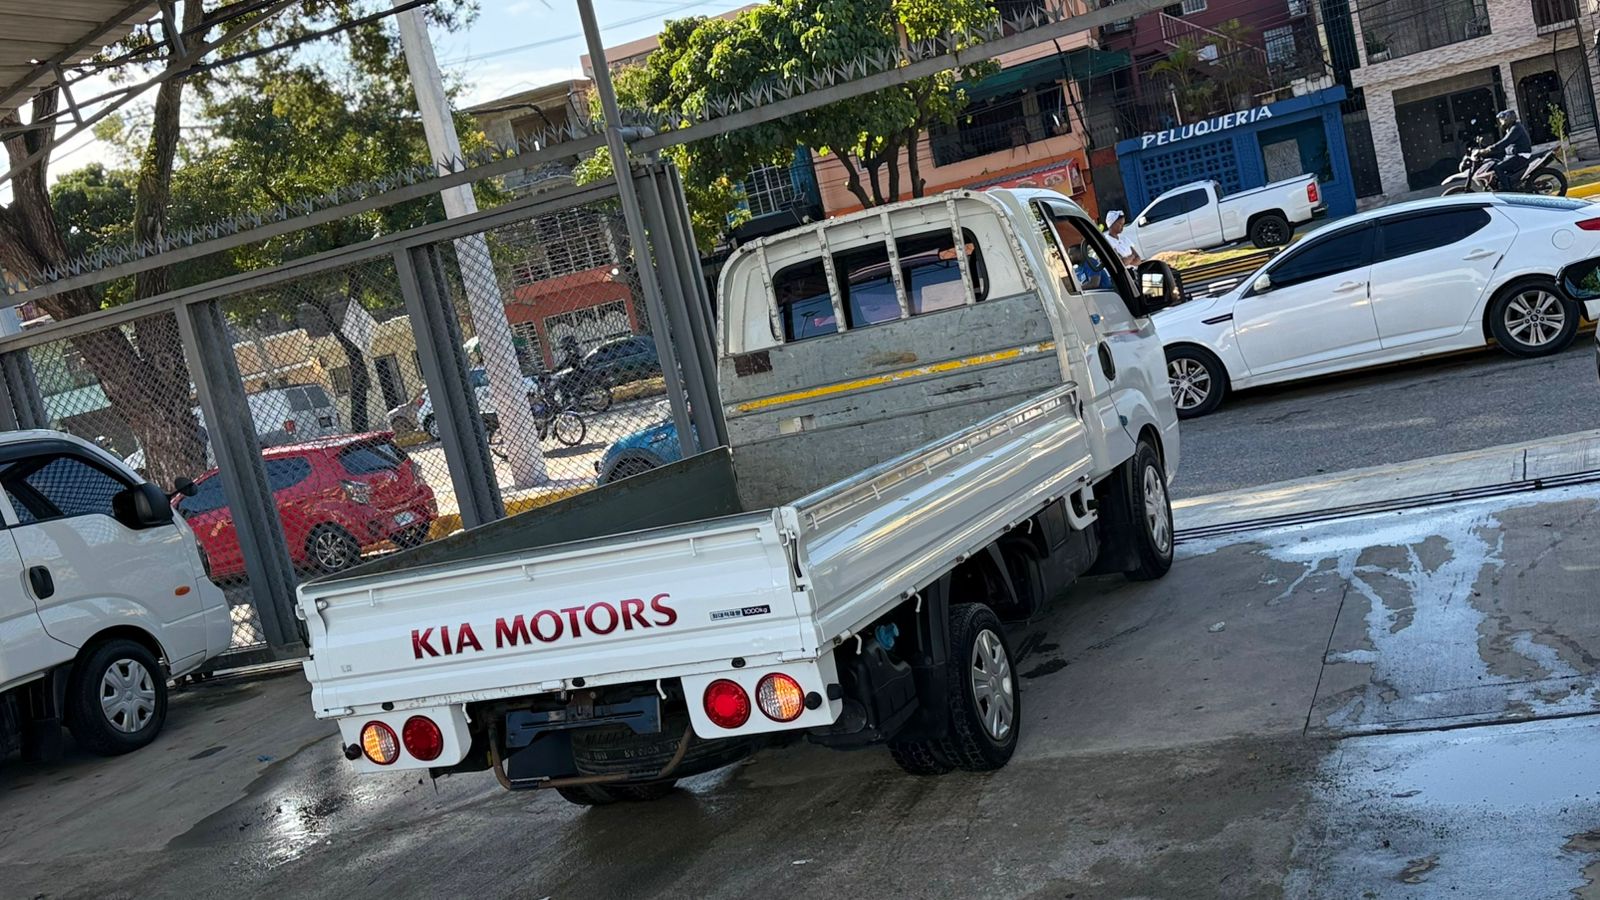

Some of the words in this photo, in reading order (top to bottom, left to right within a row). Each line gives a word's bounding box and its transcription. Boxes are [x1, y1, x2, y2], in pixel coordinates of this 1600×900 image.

[1141, 105, 1273, 149] PELUQUERIA
[411, 622, 484, 660] KIA
[494, 593, 678, 648] MOTORS
